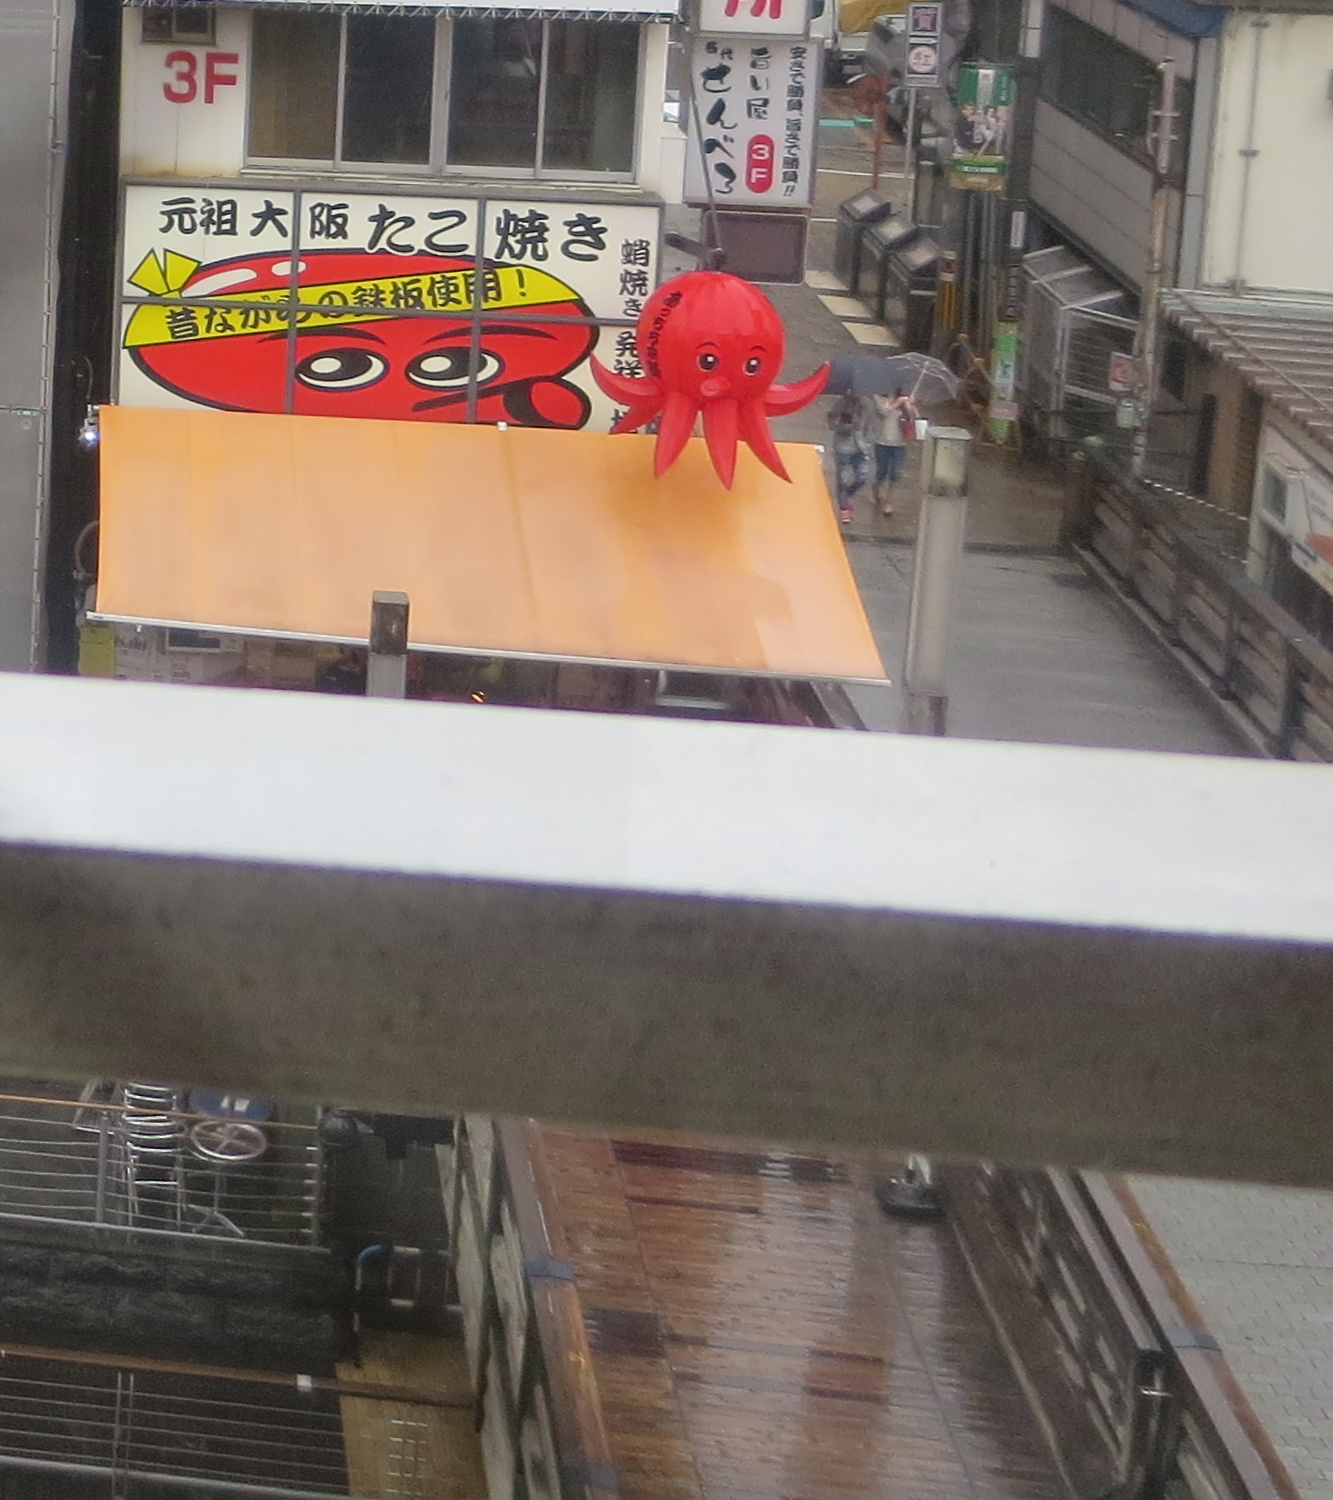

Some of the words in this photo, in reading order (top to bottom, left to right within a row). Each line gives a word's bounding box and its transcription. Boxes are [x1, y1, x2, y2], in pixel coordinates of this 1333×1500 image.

[162, 49, 240, 104] 3F
[158, 196, 610, 263] 元祖大阪たこ焼き
